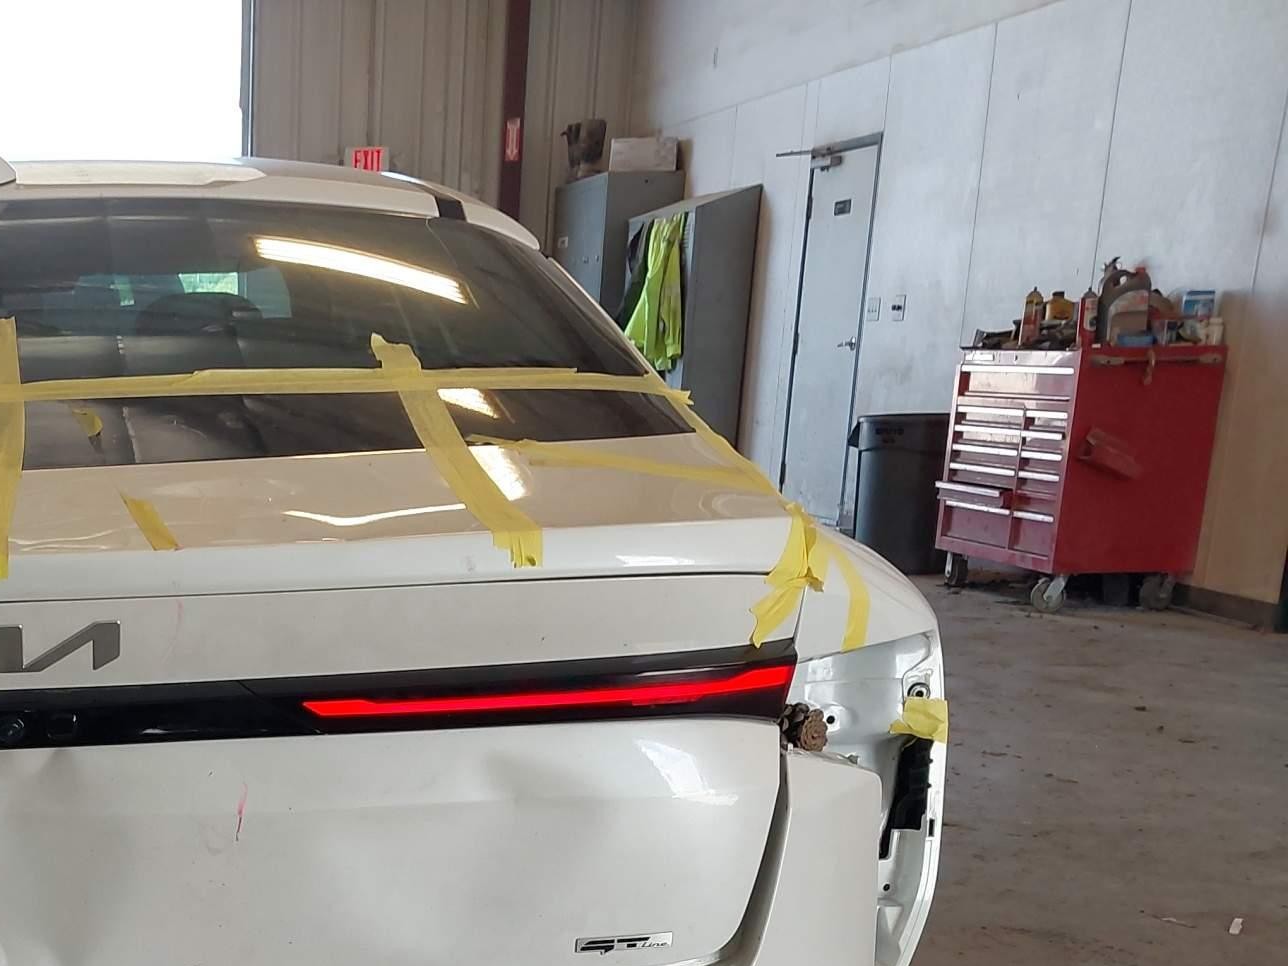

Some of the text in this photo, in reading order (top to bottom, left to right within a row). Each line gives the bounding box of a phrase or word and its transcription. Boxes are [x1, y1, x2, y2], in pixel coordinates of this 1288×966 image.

[353, 149, 382, 172] EXIT
[580, 936, 668, 955] GT Line
